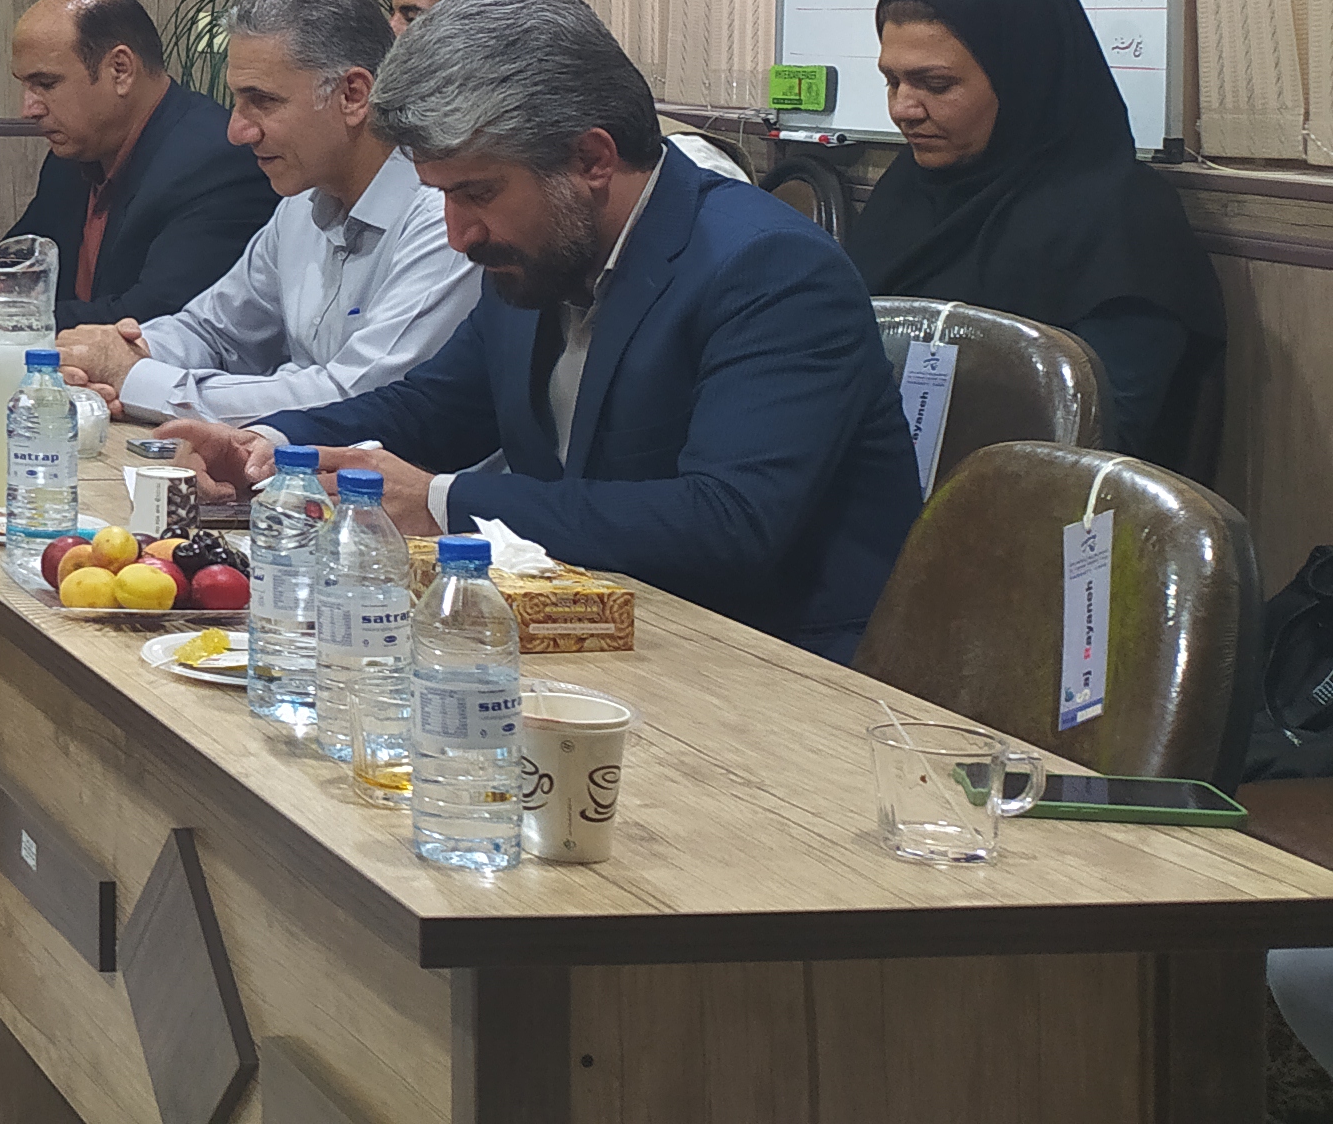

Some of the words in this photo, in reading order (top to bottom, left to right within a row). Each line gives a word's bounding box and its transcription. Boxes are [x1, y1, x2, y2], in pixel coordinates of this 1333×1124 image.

[912, 391, 929, 445] ayaneh
[14, 452, 59, 463] satrap
[1082, 580, 1094, 660] Rayaneh
